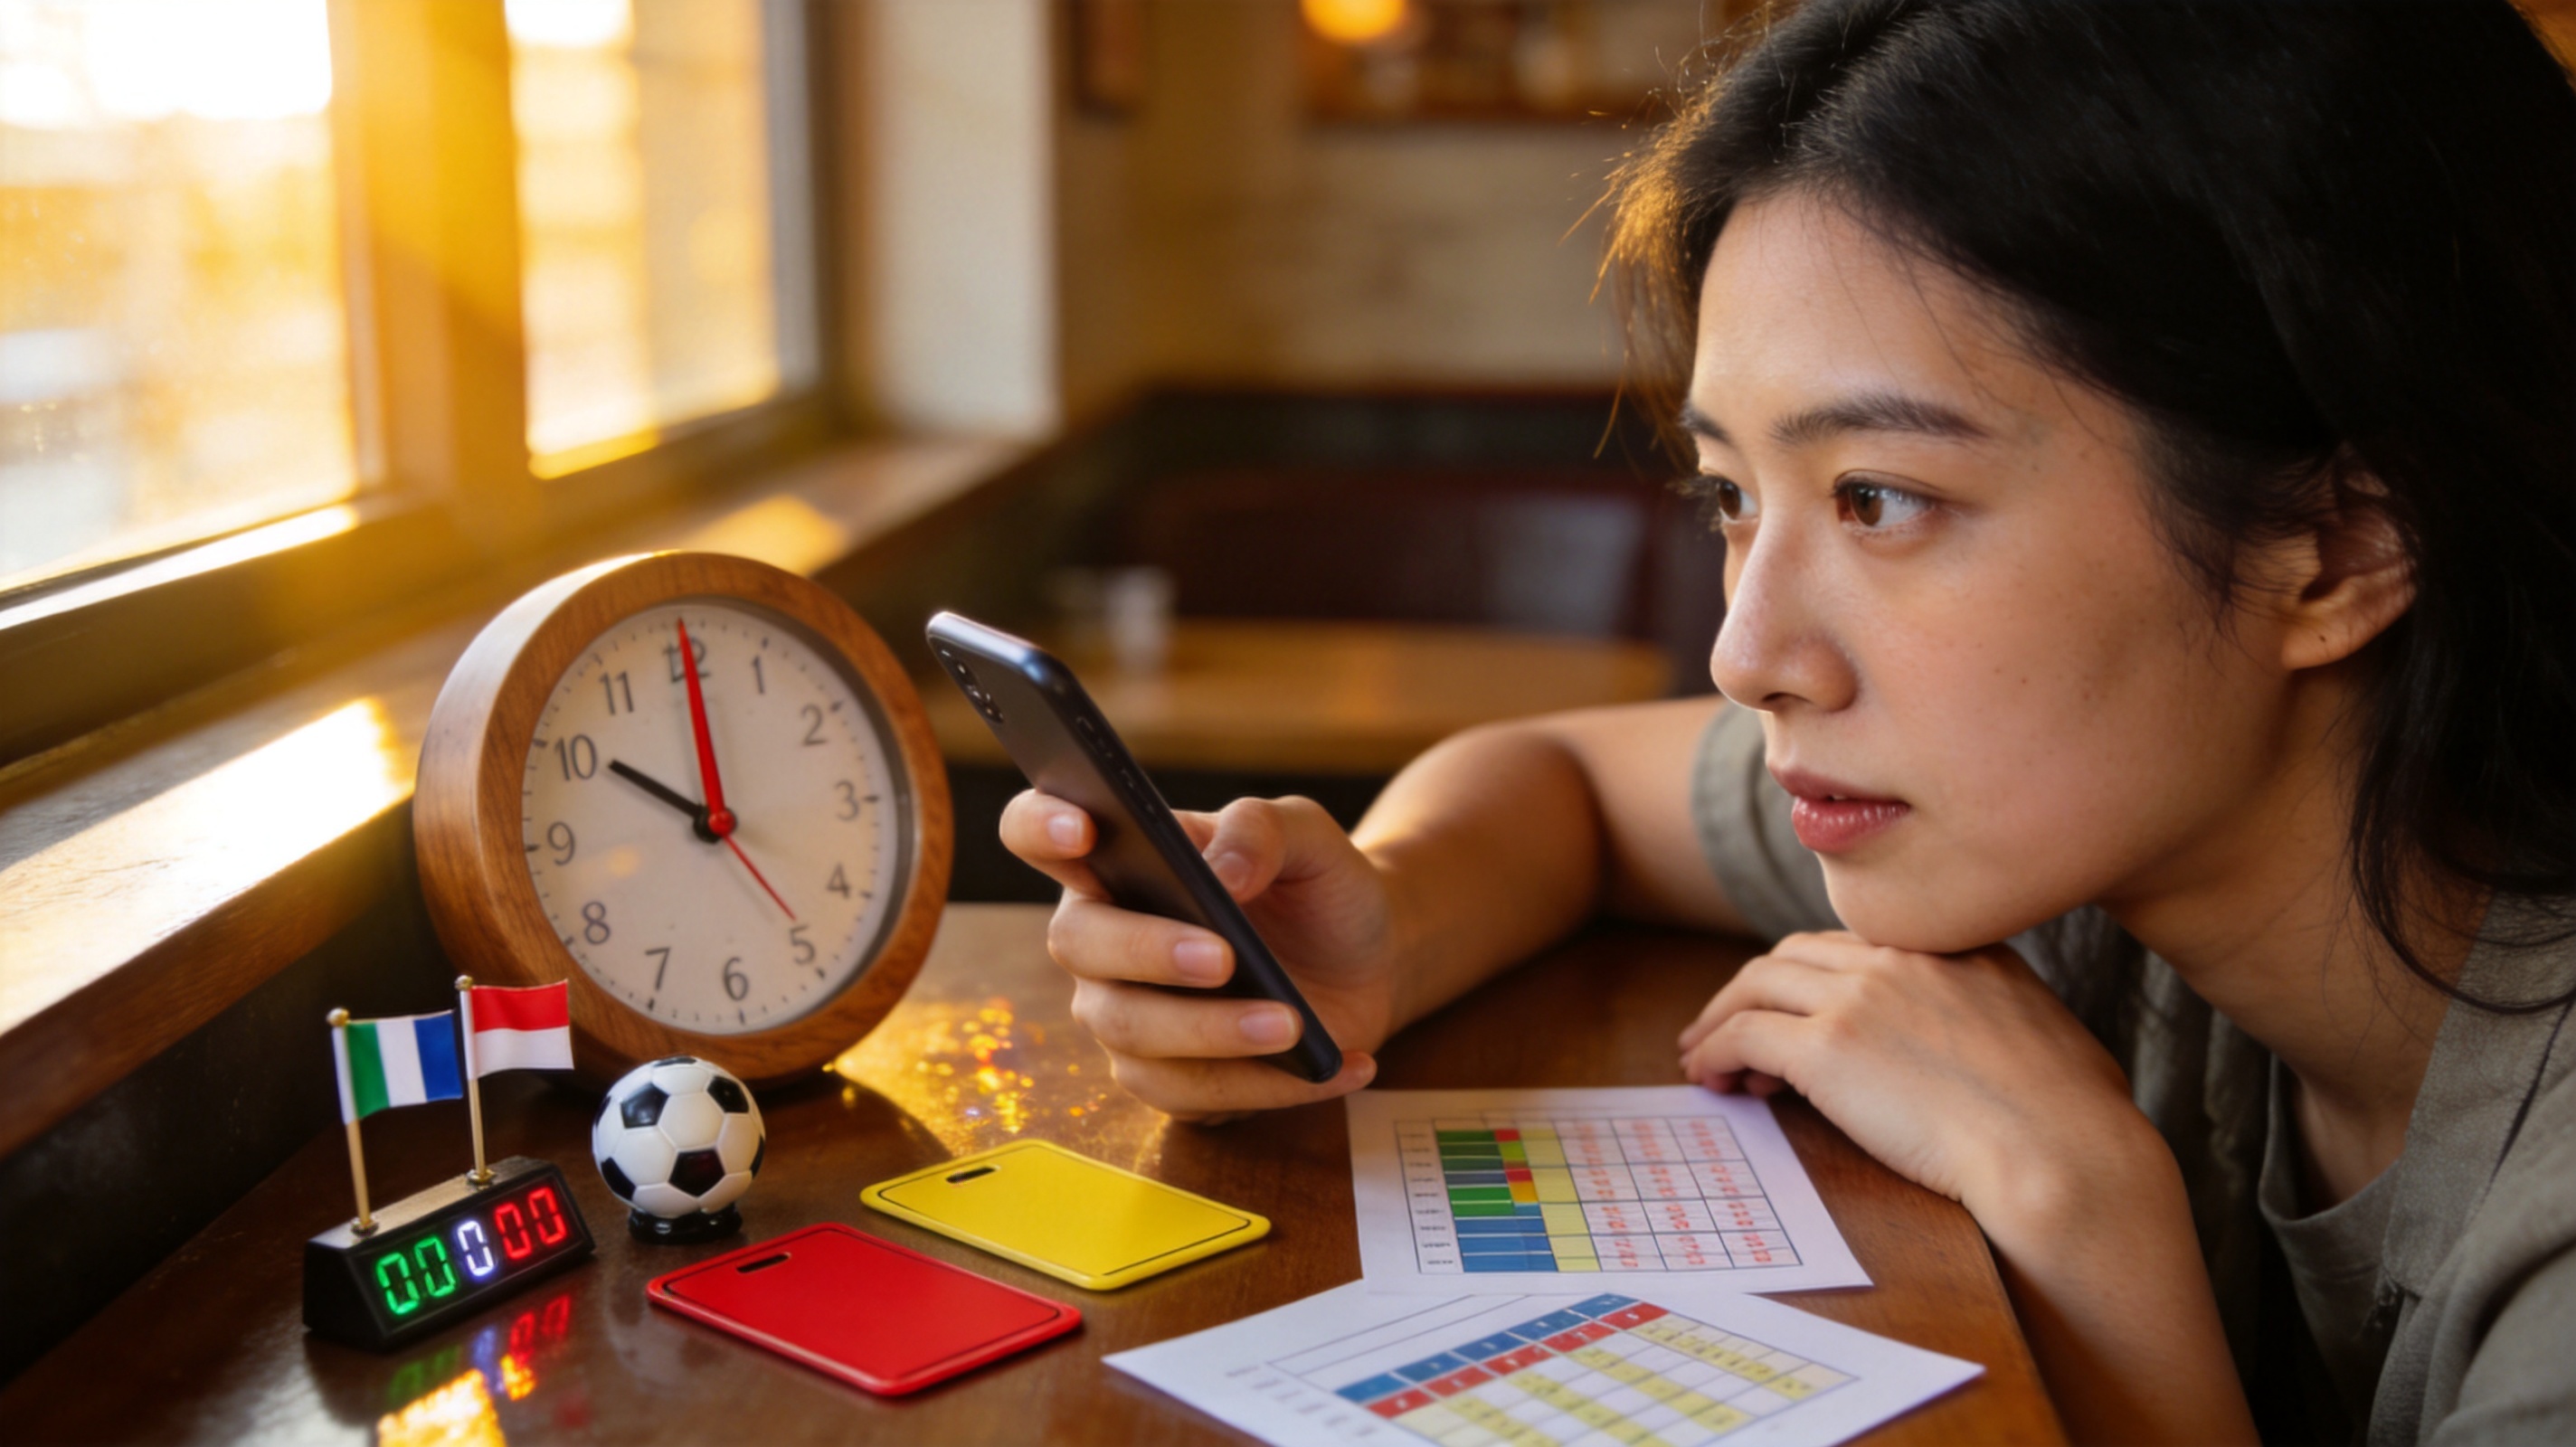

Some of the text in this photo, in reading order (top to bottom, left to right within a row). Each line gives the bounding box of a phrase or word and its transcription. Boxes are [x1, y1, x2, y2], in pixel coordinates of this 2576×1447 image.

[599, 671, 635, 715] 11
[752, 655, 766, 695] 1
[801, 704, 828, 746] 2
[554, 733, 597, 781] 10
[834, 780, 859, 821] 3
[547, 821, 575, 865] 9
[827, 864, 851, 899] 4
[582, 901, 611, 944] 8
[789, 924, 815, 965] 5
[645, 947, 671, 991] 7
[724, 957, 749, 1000] 6
